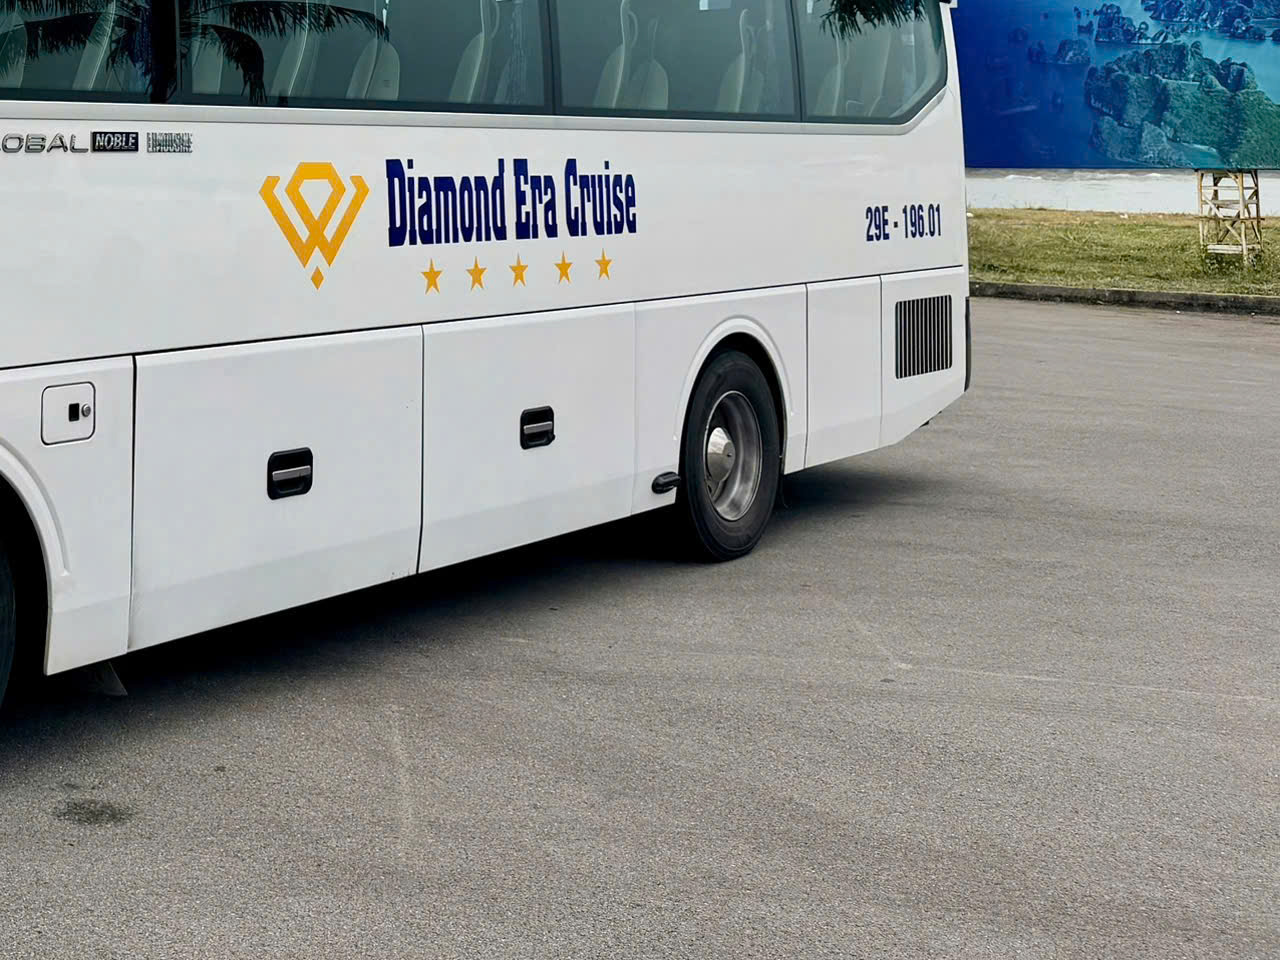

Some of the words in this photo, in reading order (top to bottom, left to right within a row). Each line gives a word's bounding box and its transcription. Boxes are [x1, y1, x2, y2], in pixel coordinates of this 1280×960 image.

[95, 133, 136, 151] NOBLE
[386, 158, 507, 247] Diamond
[513, 158, 558, 239] Era
[565, 158, 637, 237] Cruise
[865, 205, 890, 242] 29E
[902, 203, 942, 239] 196.01
